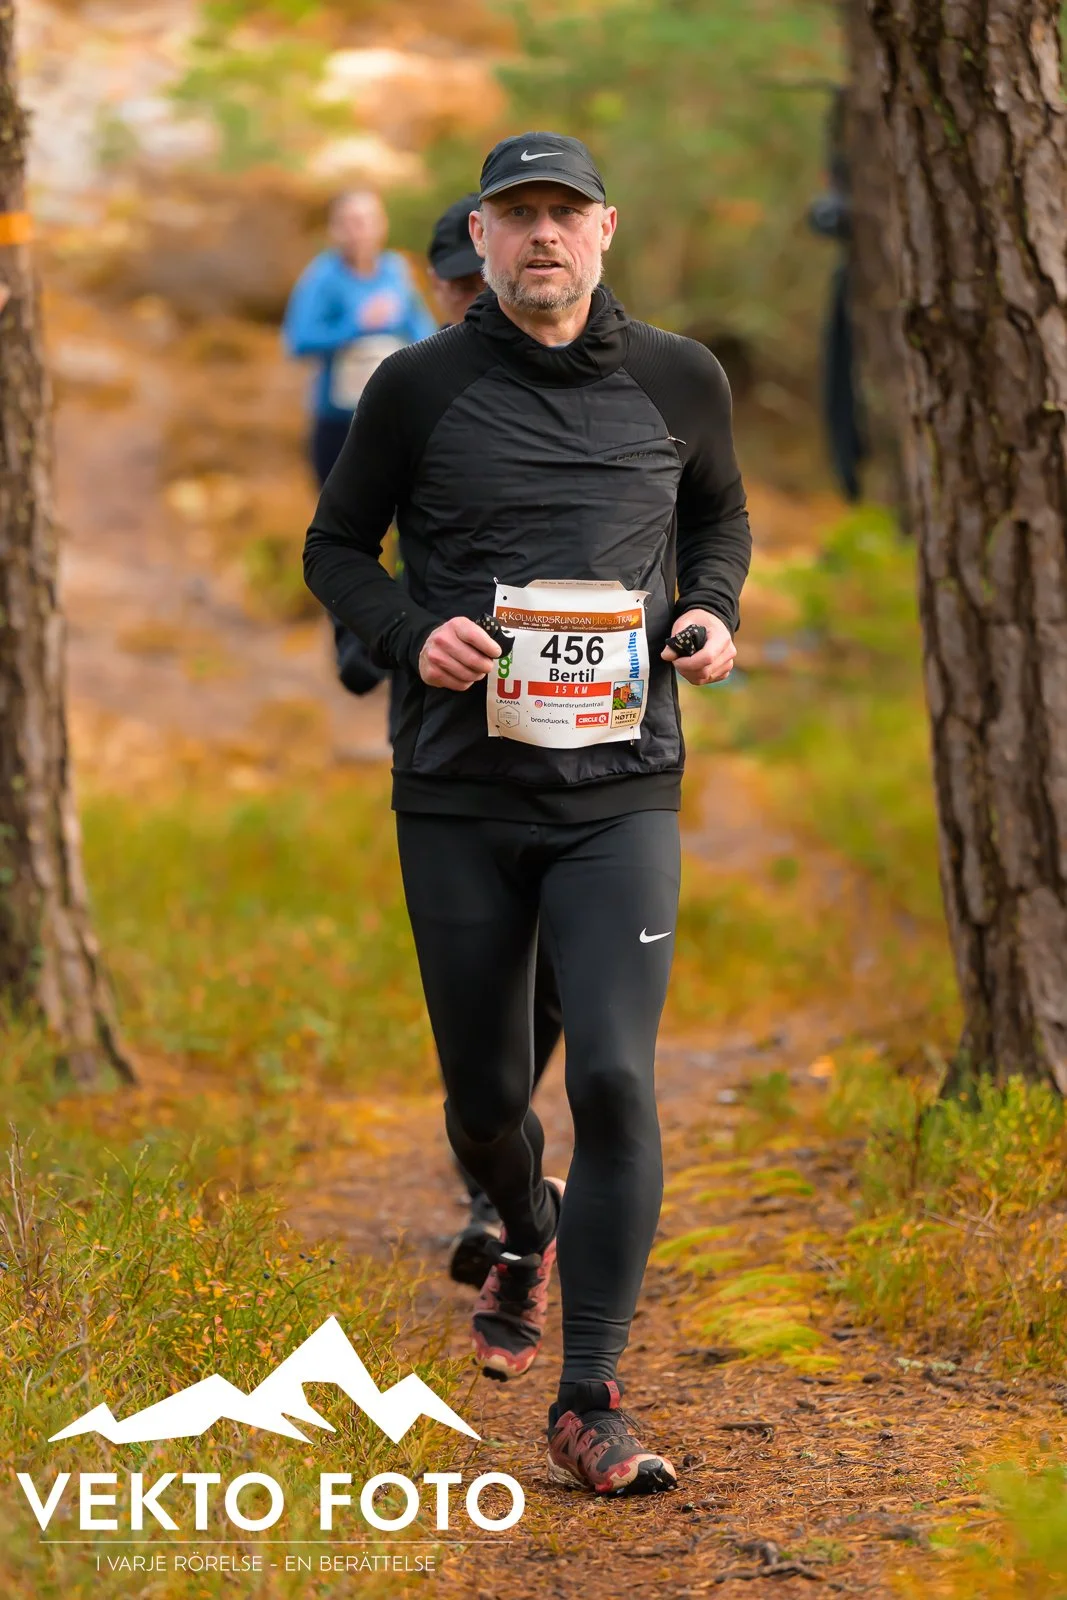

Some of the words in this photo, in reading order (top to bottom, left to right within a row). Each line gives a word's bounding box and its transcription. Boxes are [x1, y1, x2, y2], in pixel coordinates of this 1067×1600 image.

[540, 634, 604, 665] 456
[628, 632, 640, 679] Aktivitus
[549, 668, 595, 683] Bertil
[555, 685, 567, 694] 15
[574, 686, 588, 695] KM
